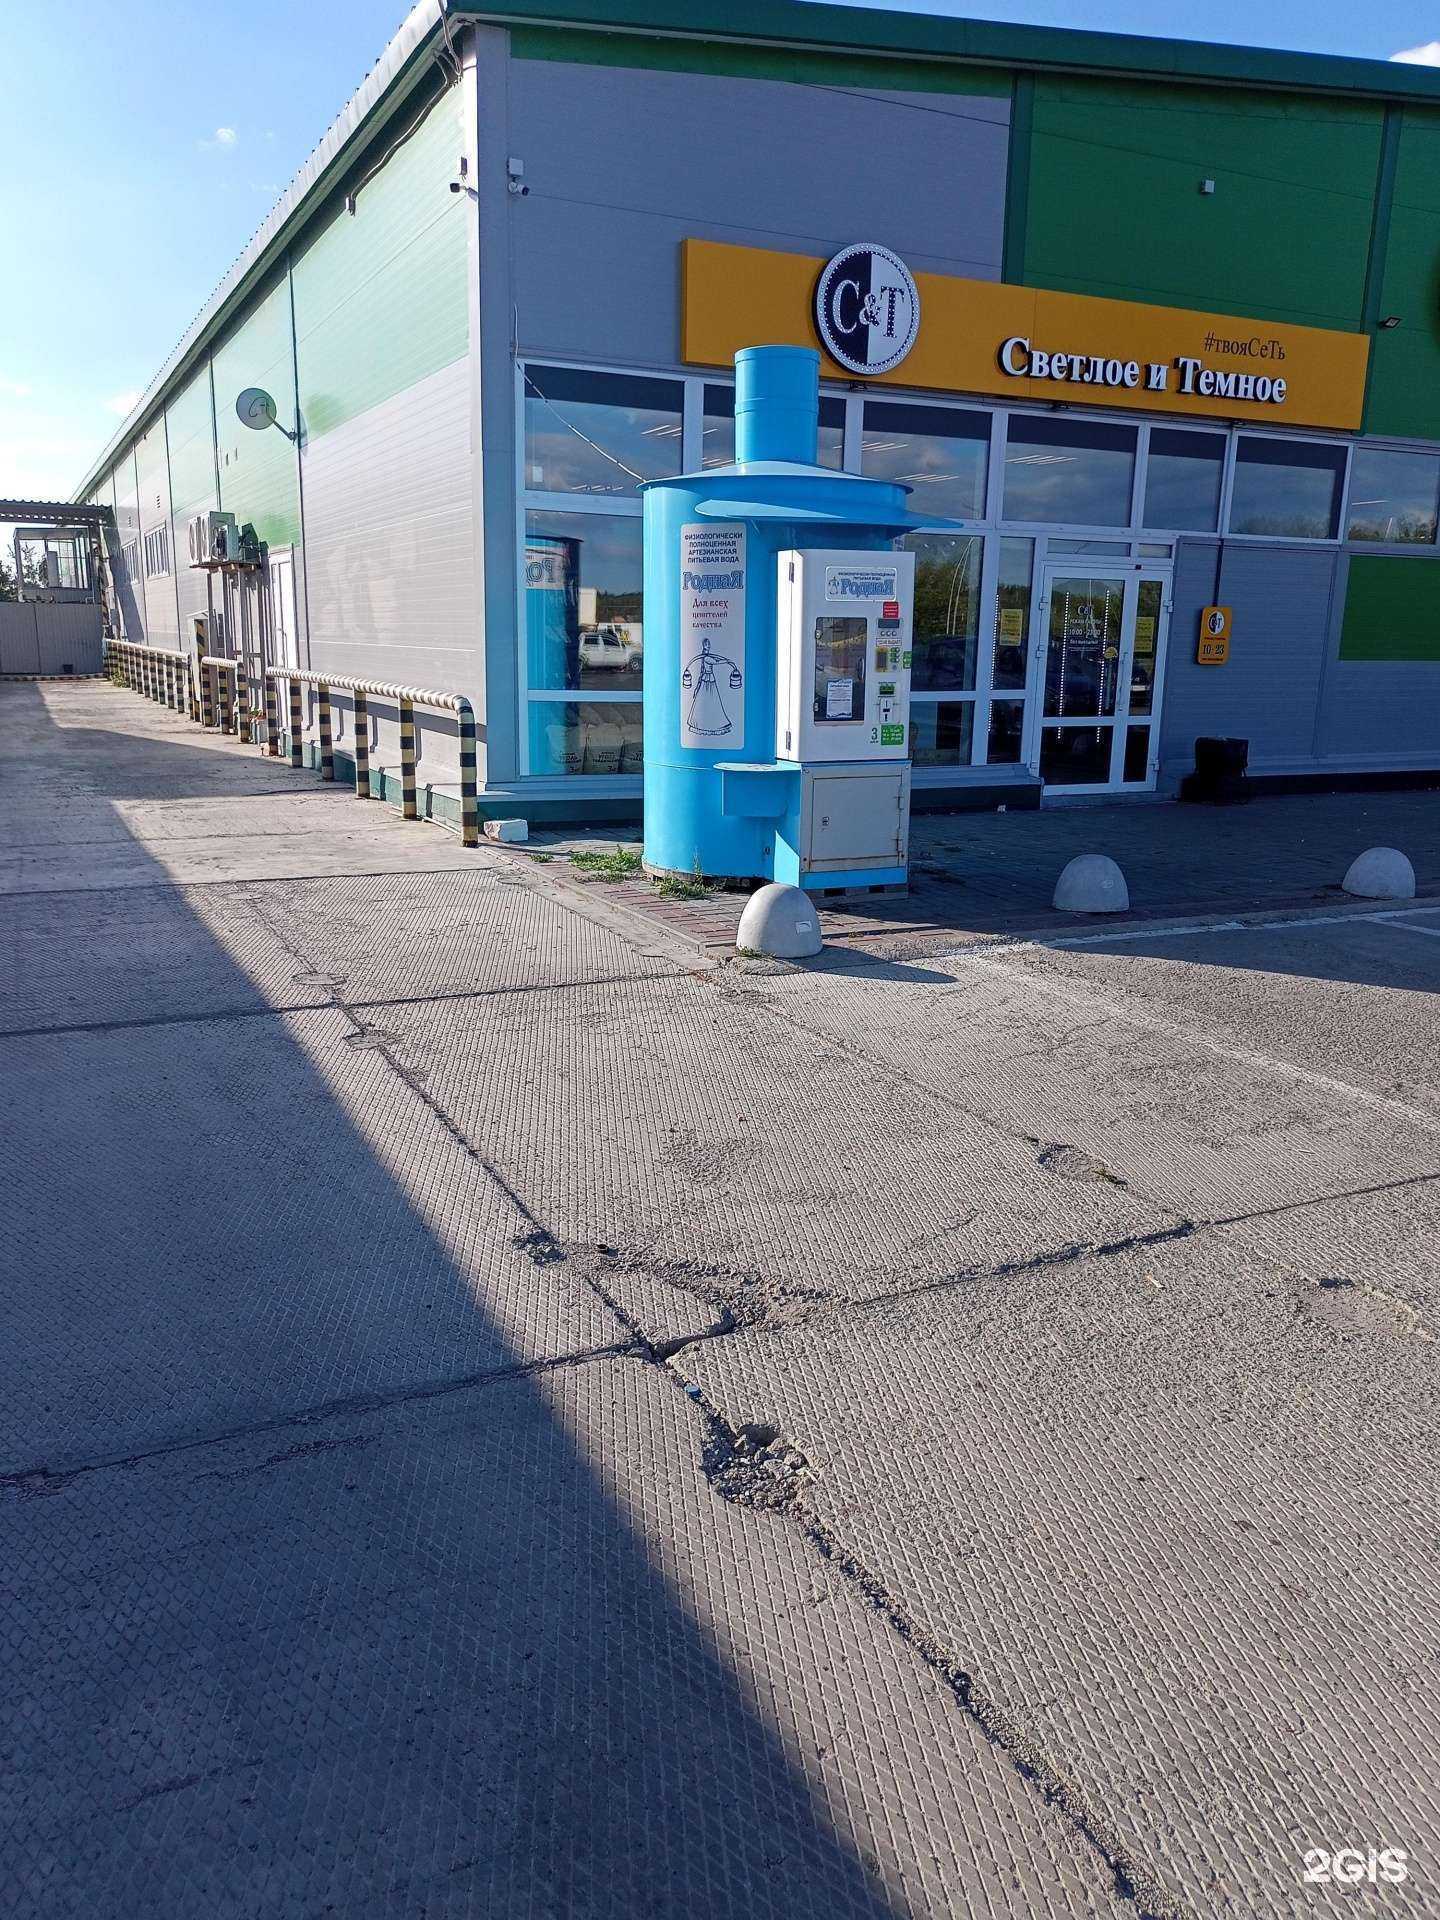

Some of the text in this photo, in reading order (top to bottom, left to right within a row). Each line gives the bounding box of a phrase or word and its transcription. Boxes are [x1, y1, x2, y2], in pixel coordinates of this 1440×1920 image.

[999, 336, 1287, 403] Светлое и Темное
[684, 532, 743, 541] ФИЗИОЛОГИЧЕСКИ
[689, 540, 737, 548] ПОЛНОЦЕННАЯ
[688, 548, 737, 556] АРТЕЗИАНСКАЯ
[687, 556, 719, 564] ПИТЬЕВАЯ
[692, 598, 729, 609] Для всех
